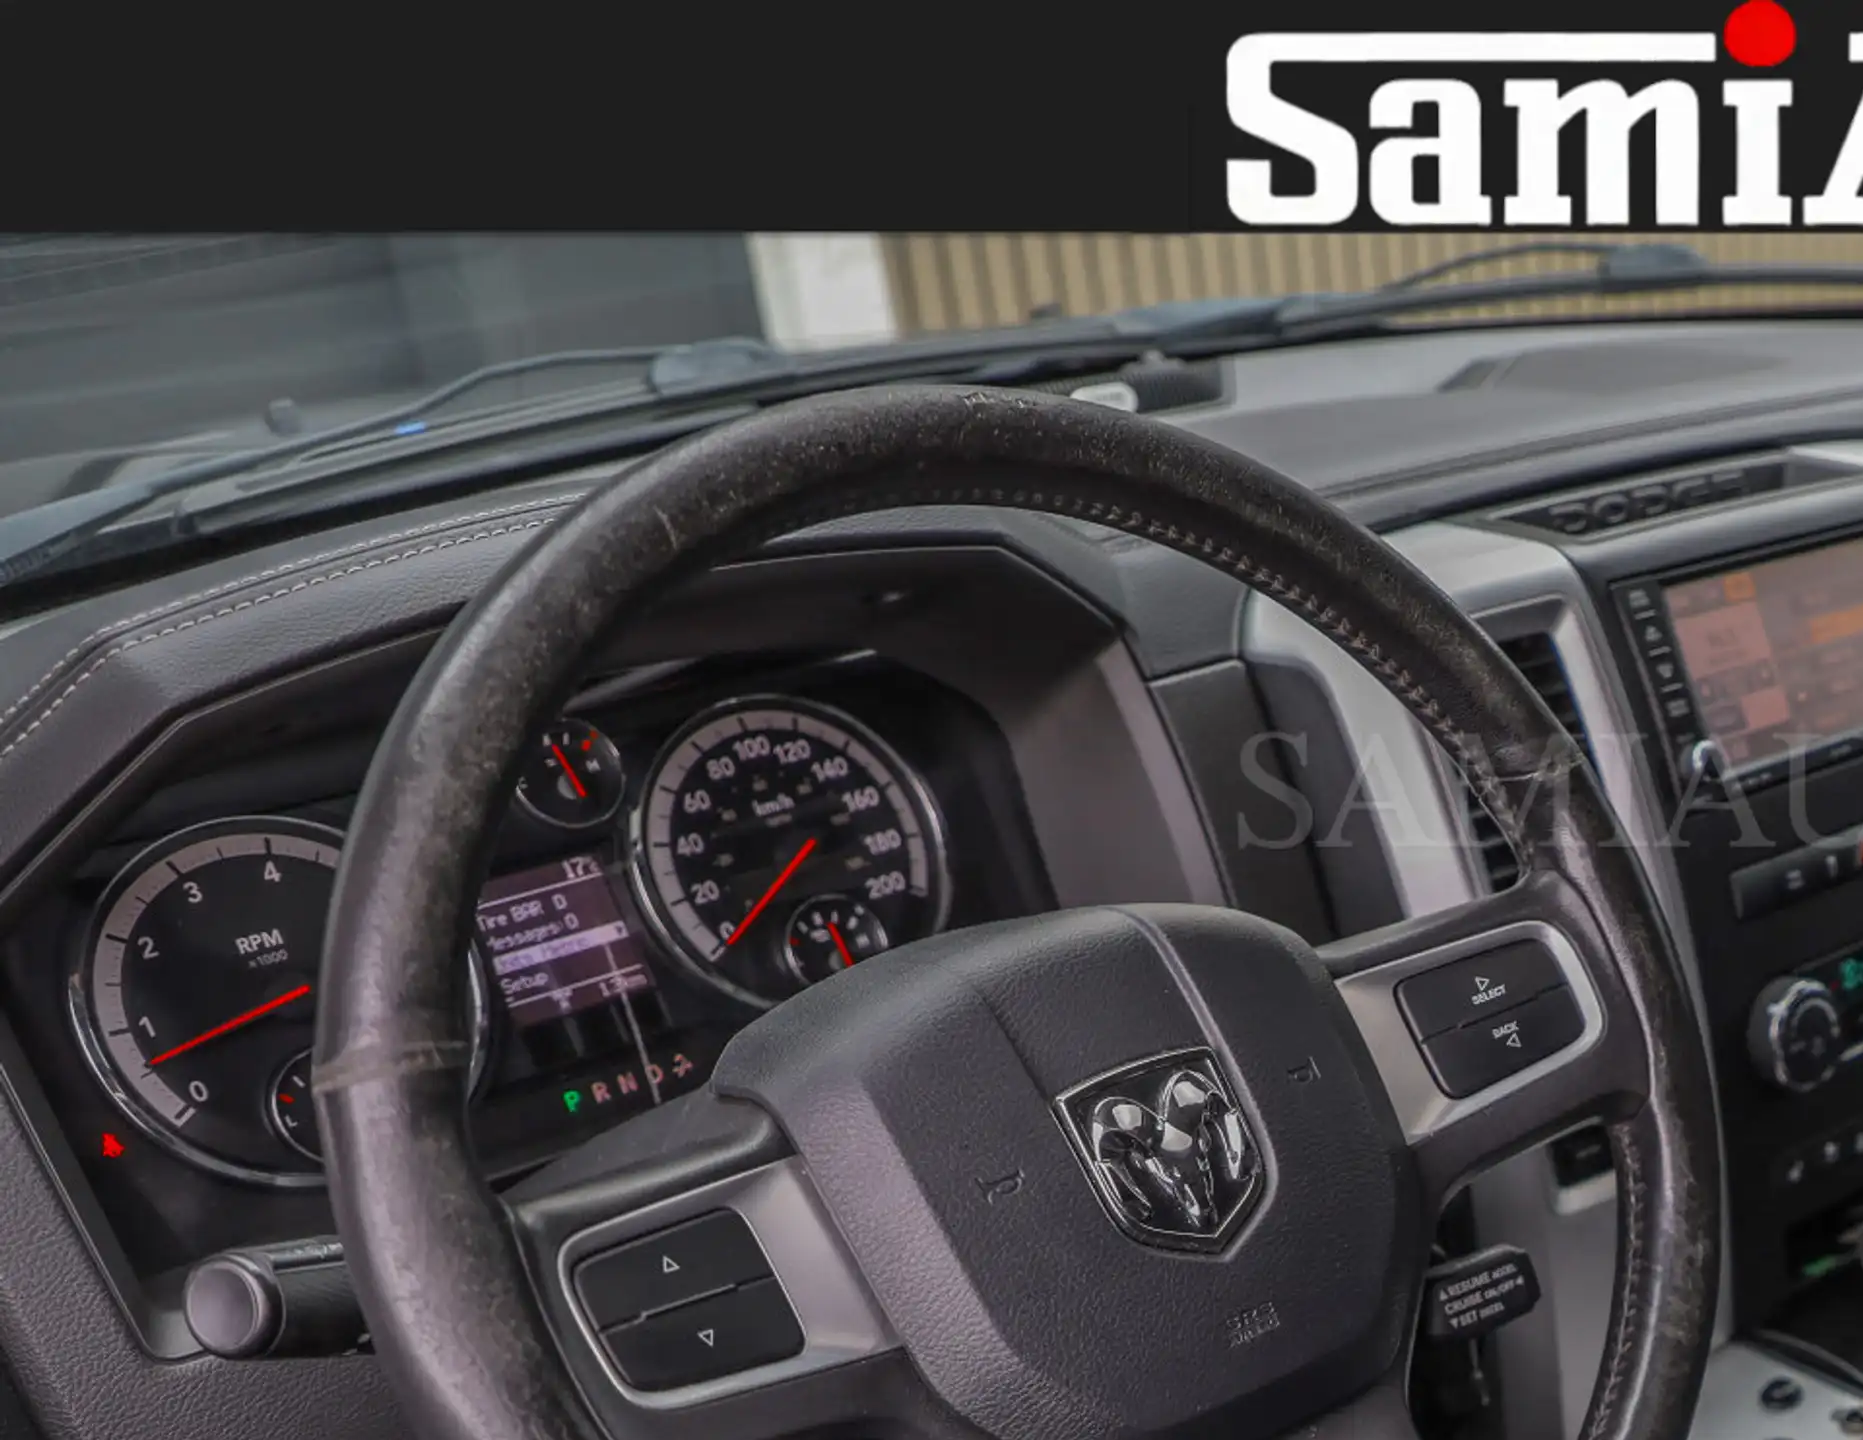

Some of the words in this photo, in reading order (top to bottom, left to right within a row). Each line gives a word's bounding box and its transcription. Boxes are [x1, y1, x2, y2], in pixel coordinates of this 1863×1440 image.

[733, 736, 771, 761] 100
[773, 739, 811, 764] 120
[706, 756, 735, 781] 80
[810, 756, 849, 782] 140
[683, 790, 711, 813] 60
[842, 786, 880, 813] 160
[677, 833, 704, 856] 40
[863, 829, 902, 856] 180
[263, 861, 281, 882] 4
[183, 881, 203, 903] 3
[690, 880, 720, 905] 20
[864, 871, 906, 900] 200
[138, 937, 160, 959] 2
[235, 929, 284, 955] RPM
[1471, 984, 1506, 1005] SELECT
[139, 1016, 156, 1039] 1
[1492, 1020, 1520, 1039] BACK
[189, 1080, 209, 1102] 0
[563, 1090, 580, 1112] P
[591, 1081, 612, 1104] R
[617, 1072, 639, 1095] N
[1447, 1271, 1490, 1296] RESUME
